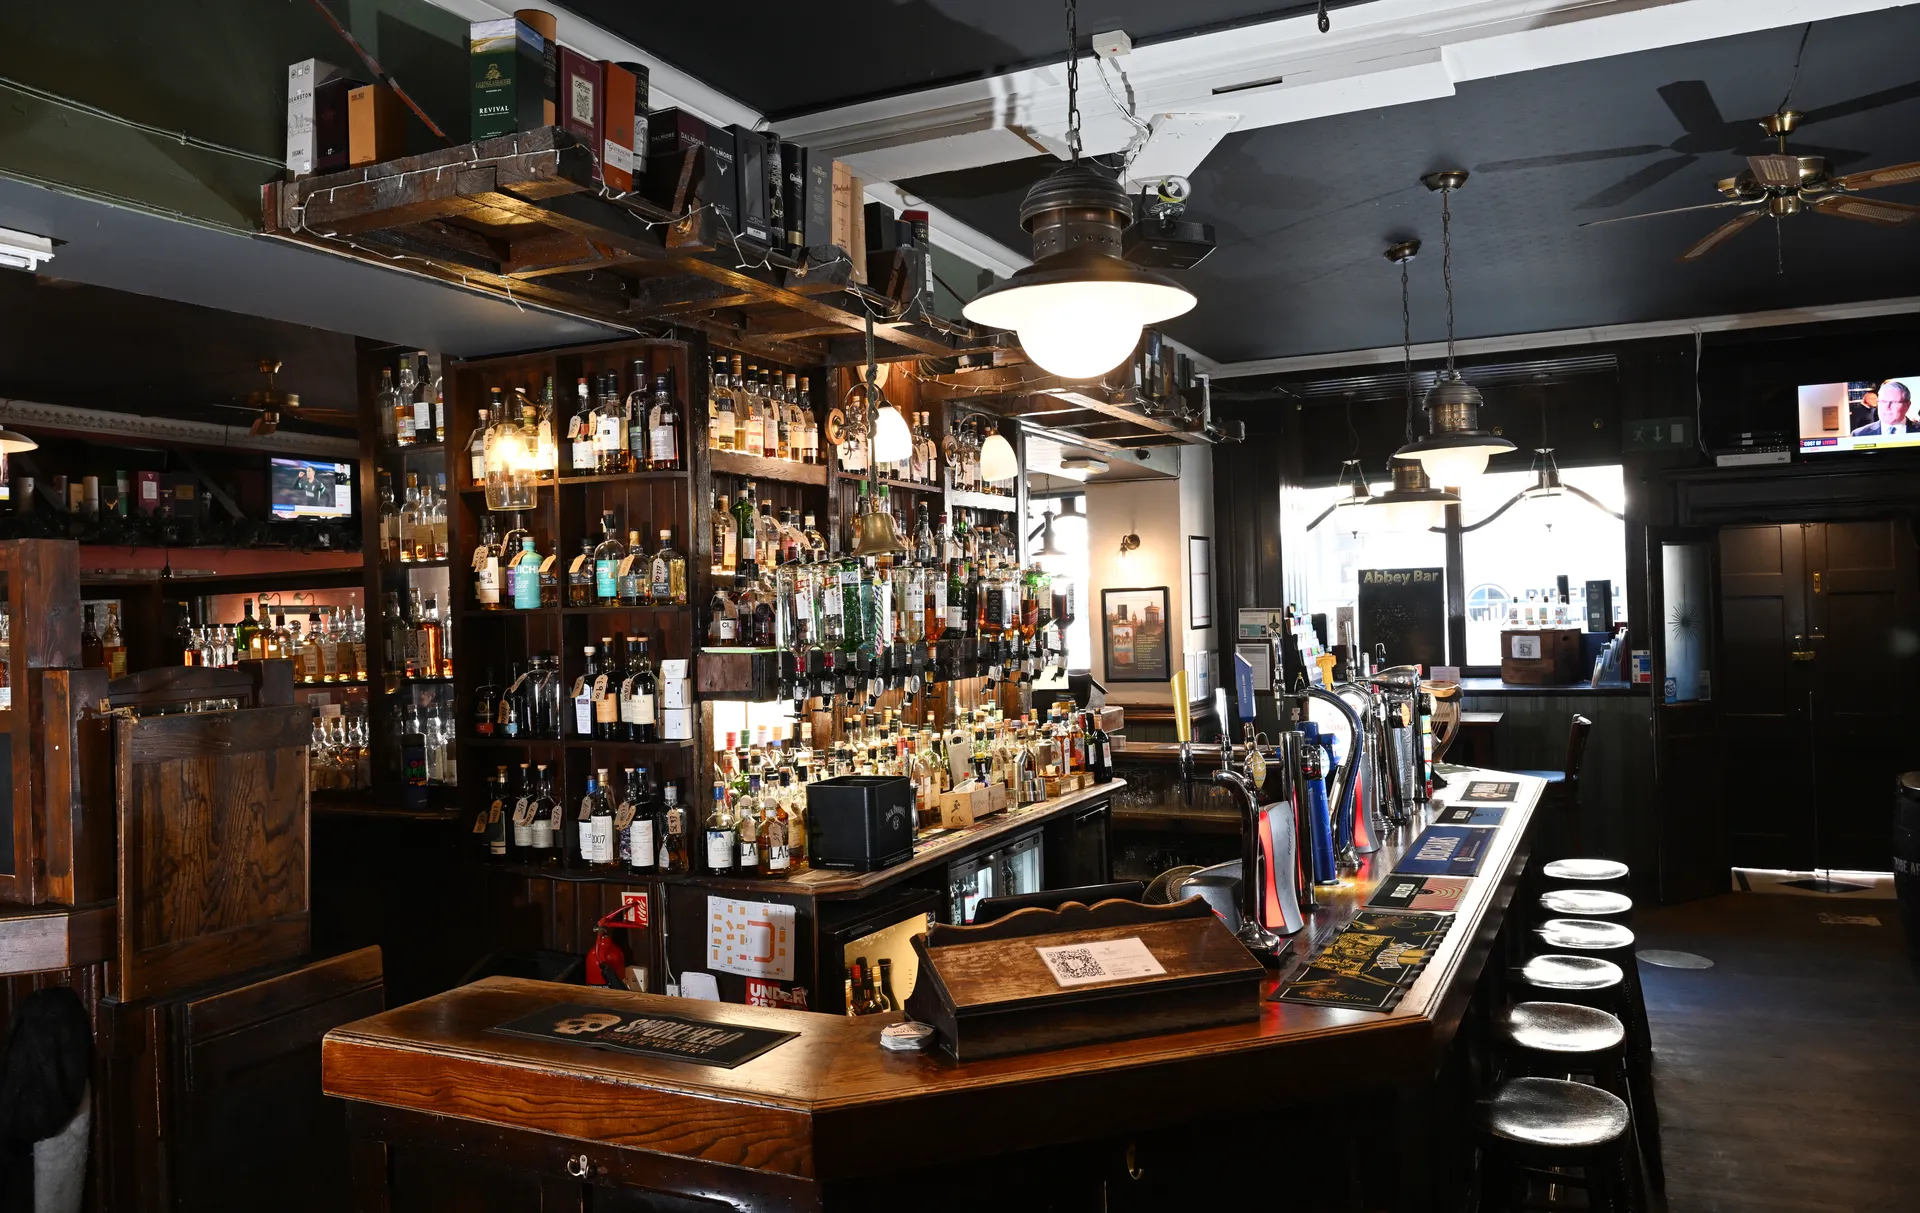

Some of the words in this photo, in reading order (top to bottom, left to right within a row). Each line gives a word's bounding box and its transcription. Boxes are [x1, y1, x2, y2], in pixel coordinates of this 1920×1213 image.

[288, 92, 312, 103] DEANSTON
[479, 105, 509, 114] REVIVAL
[651, 132, 675, 142] DALMORE
[680, 131, 705, 146] DALMORE
[1364, 571, 1411, 586] Abbey
[1414, 570, 1439, 582] Bar
[749, 982, 806, 1005] UNDR
[613, 1018, 746, 1047] SMOKEHEAD
